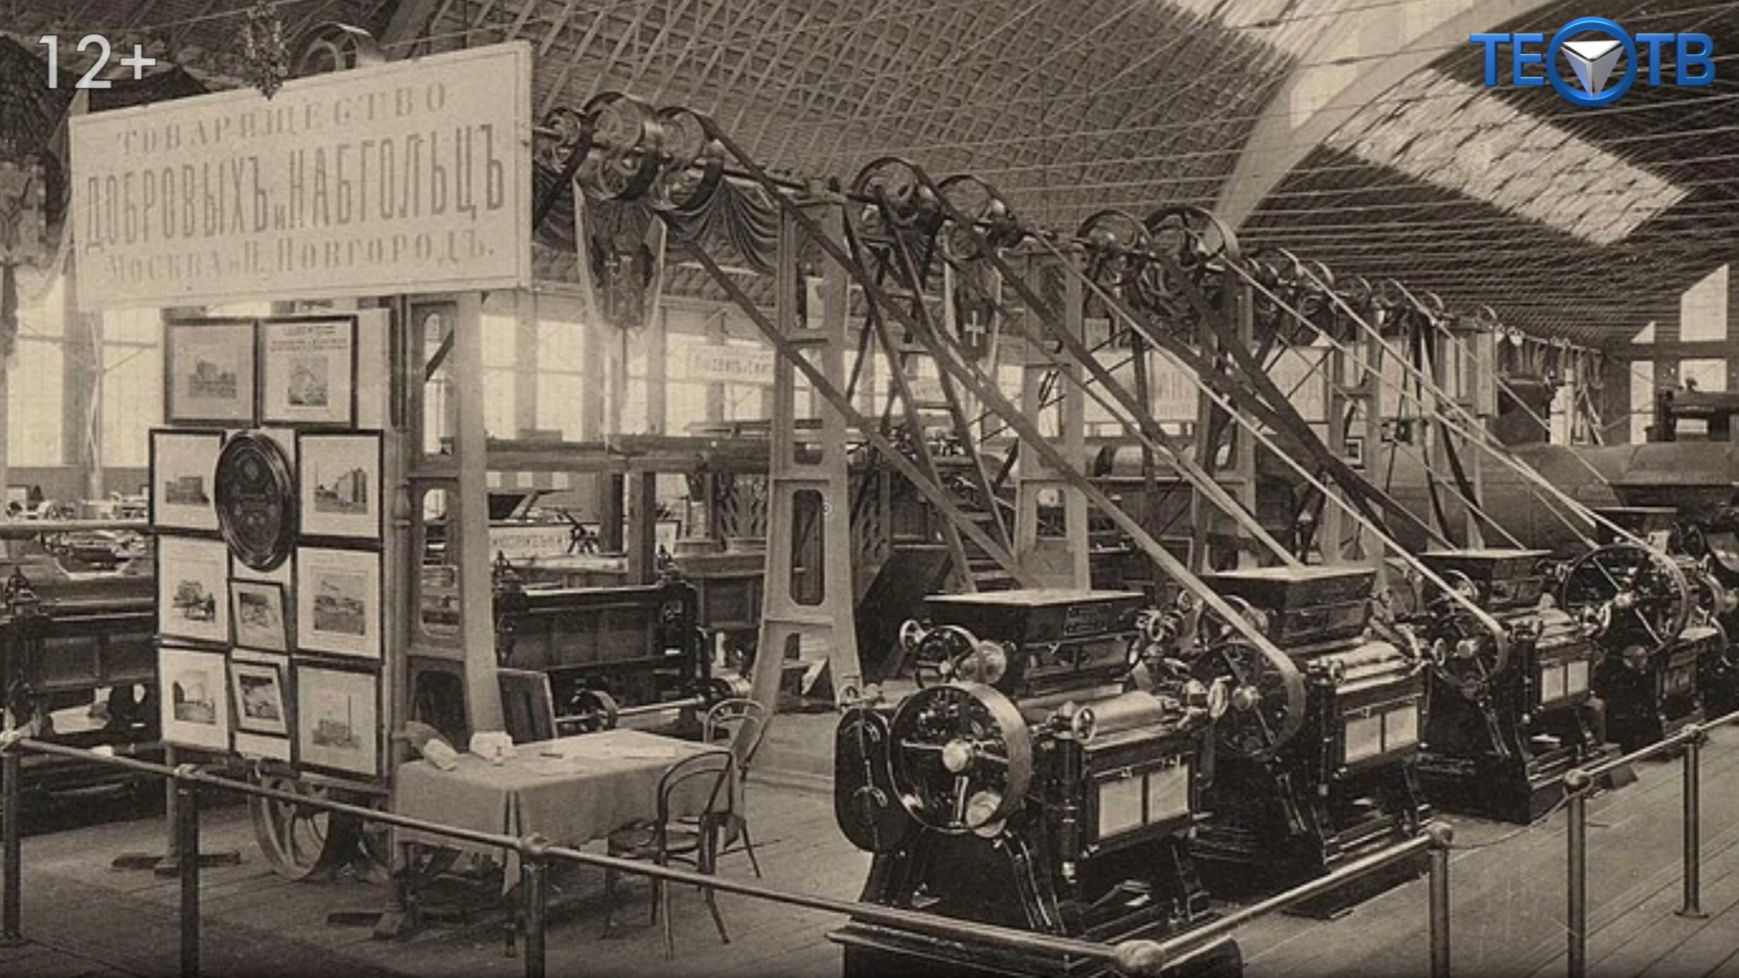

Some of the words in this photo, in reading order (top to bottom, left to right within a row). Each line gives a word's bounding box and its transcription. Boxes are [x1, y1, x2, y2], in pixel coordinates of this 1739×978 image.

[116, 82, 446, 155] ТОВАРИЩЕСТВО
[84, 156, 268, 256] ДОБРОВЫХЪ
[288, 123, 504, 230] НАБГОЛЬЦЪ
